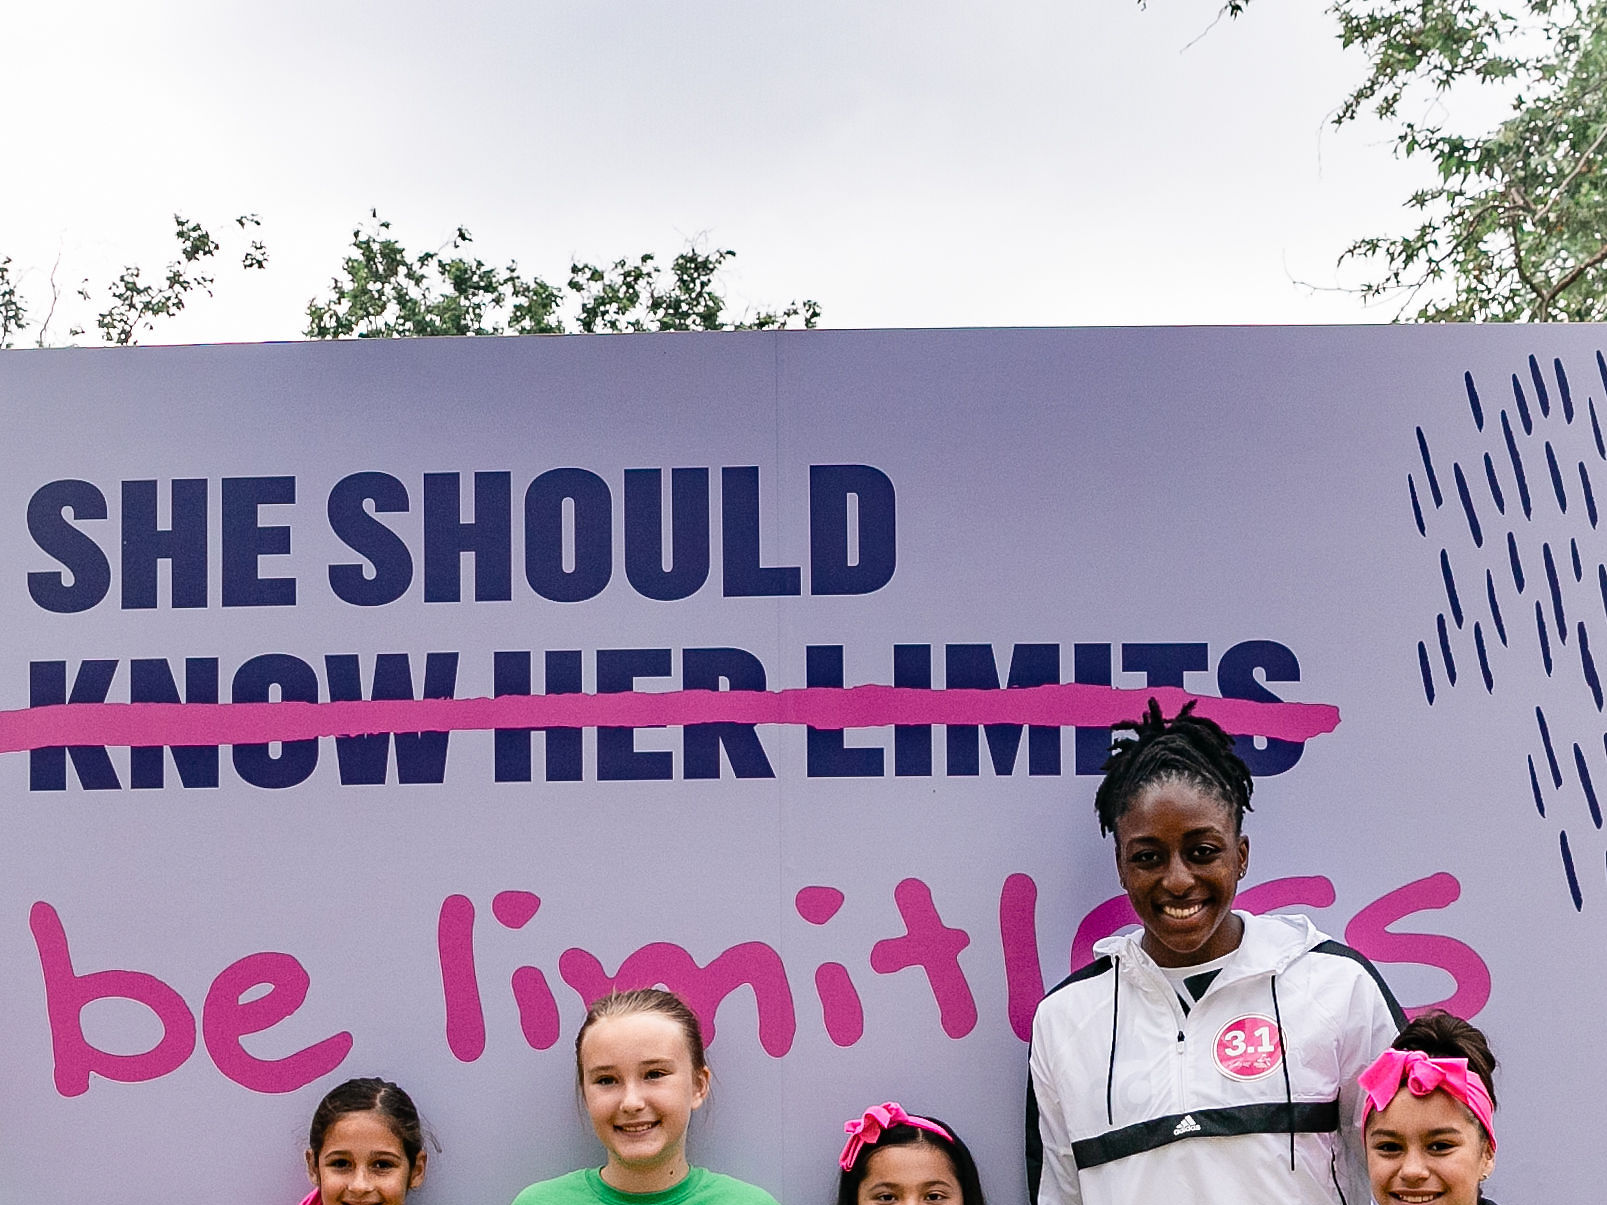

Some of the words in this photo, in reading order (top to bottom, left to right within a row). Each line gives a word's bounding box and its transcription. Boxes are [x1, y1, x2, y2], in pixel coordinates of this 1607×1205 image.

[27, 476, 297, 613] SHE
[327, 465, 897, 607] SHOULD
[29, 652, 460, 792] KNOW
[493, 647, 777, 783] HER
[29, 900, 354, 1097] be
[437, 871, 1492, 1062] limitls
[1223, 1026, 1275, 1058] 3.1
[1173, 1123, 1202, 1136] adidas
